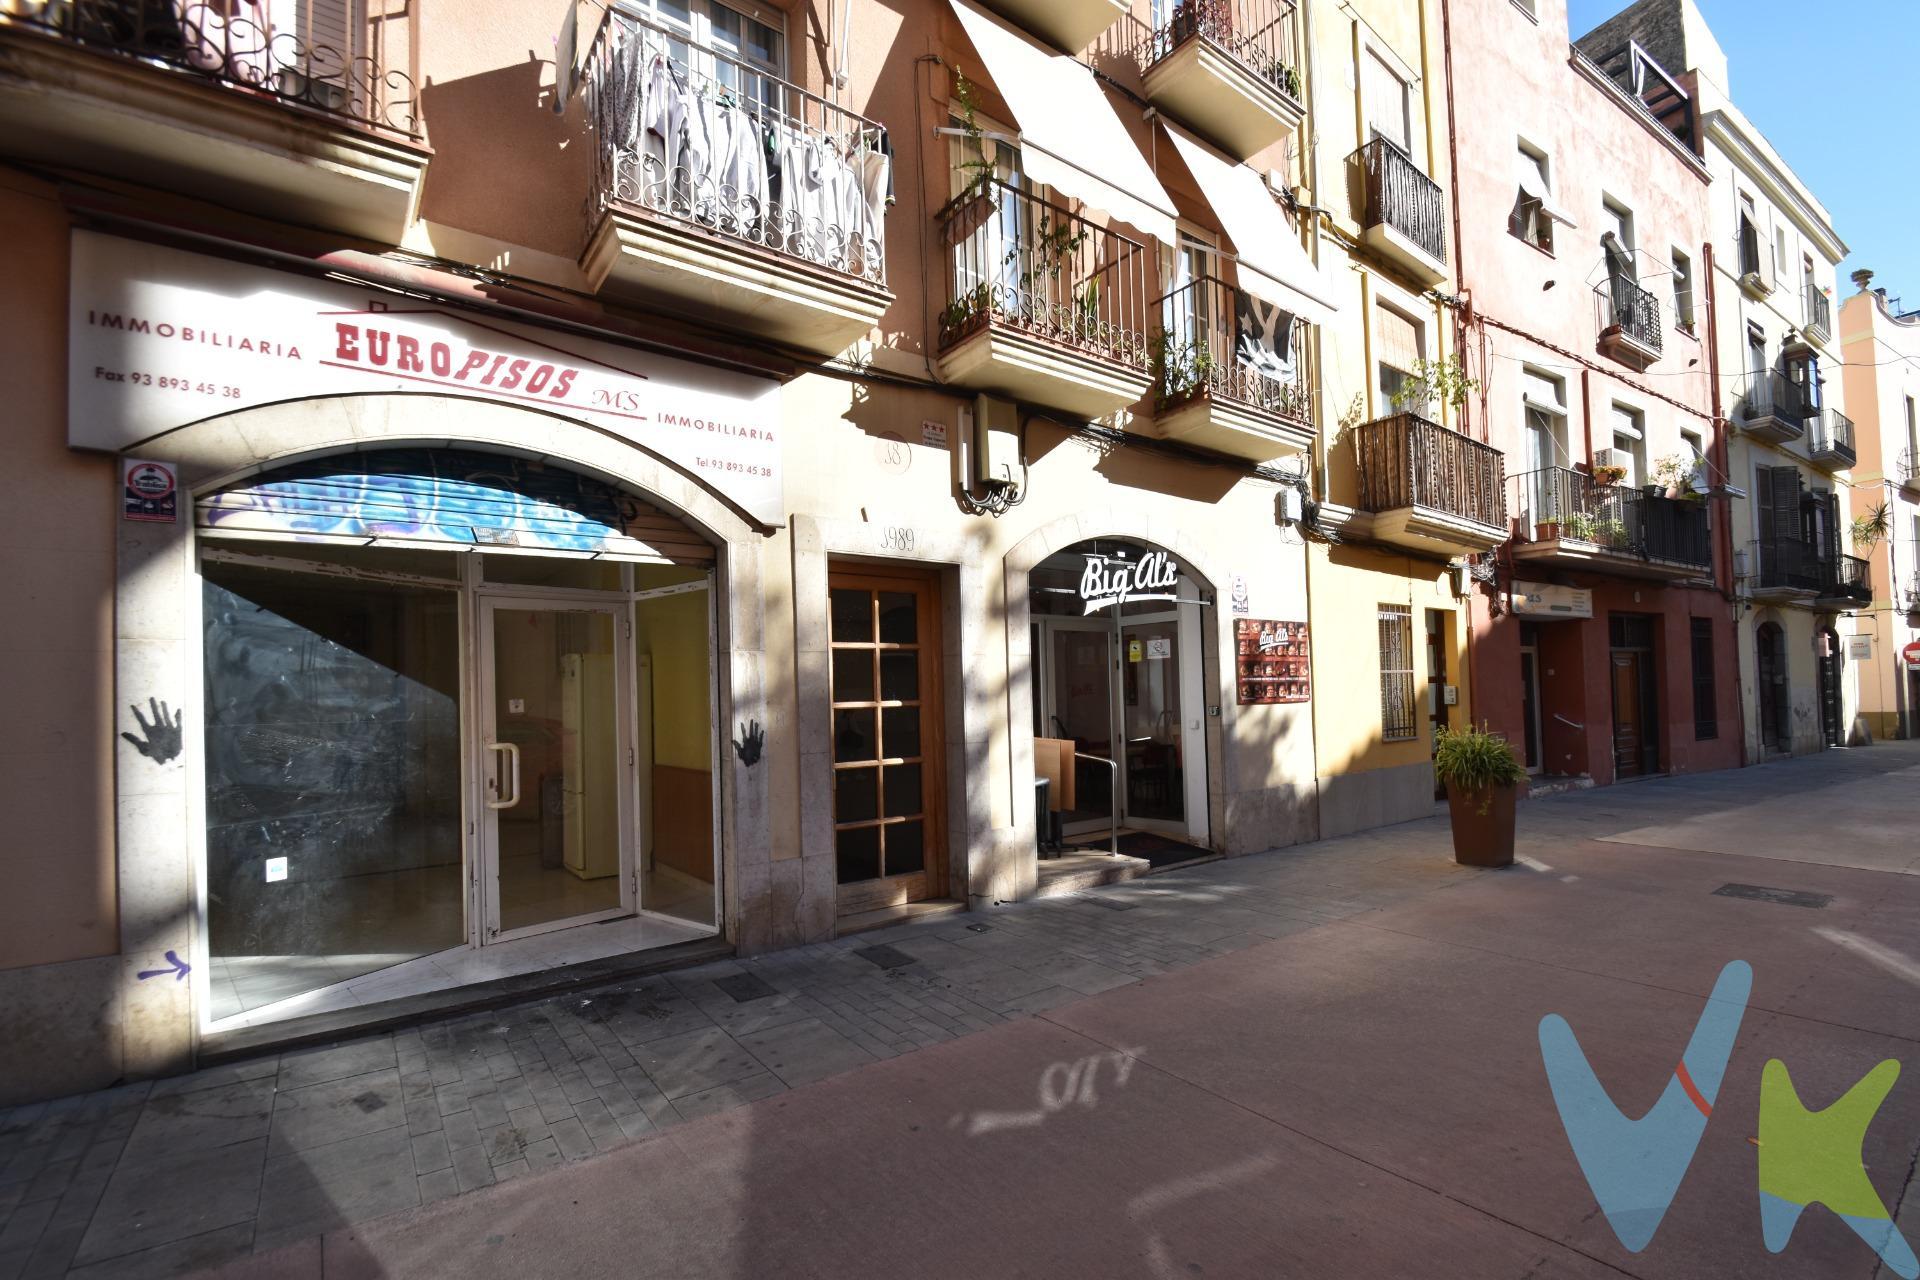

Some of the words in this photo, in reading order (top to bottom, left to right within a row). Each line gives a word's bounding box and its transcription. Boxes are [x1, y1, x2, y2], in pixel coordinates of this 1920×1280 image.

[88, 310, 302, 360] IMMOBILIARIA
[336, 322, 578, 399] EUROPISOS
[95, 366, 125, 383] Fax
[131, 372, 152, 386] 93
[158, 376, 189, 391] 893
[196, 382, 215, 395] 45
[222, 386, 241, 398] 38
[592, 389, 639, 411] MS
[657, 412, 774, 441] IMMOBILIARIA
[726, 462, 744, 473] 893
[746, 465, 758, 476] 45
[761, 467, 772, 478] 38
[1081, 557, 1133, 604] Big
[1135, 552, 1178, 590] Al's
